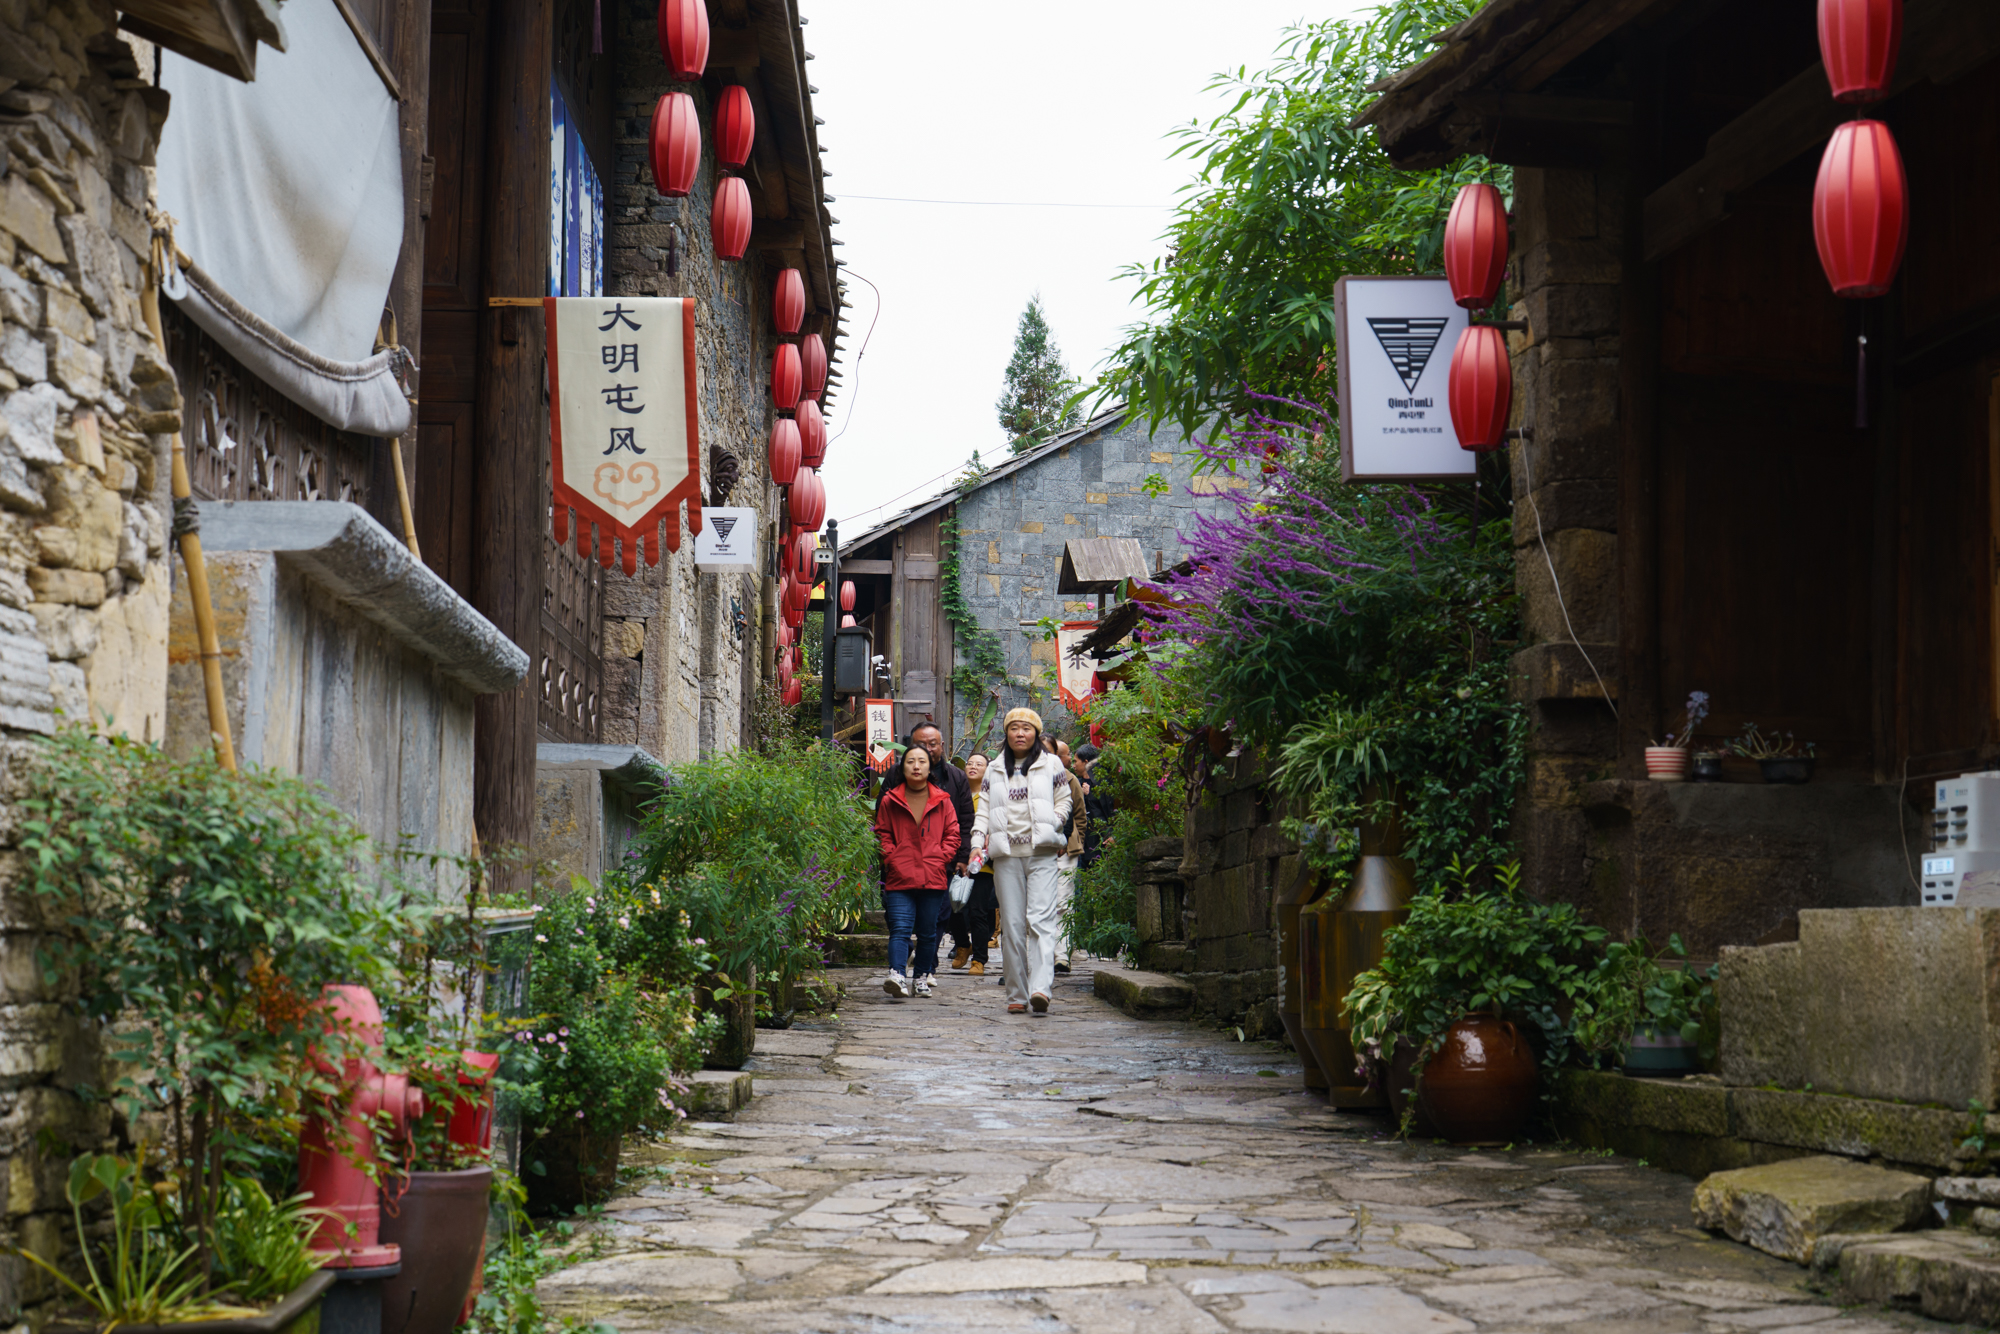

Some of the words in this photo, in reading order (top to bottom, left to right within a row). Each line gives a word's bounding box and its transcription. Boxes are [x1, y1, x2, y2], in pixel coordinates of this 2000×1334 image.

[598, 302, 646, 456] 大明屯风
[1388, 398, 1434, 409] QingTunLi
[871, 709, 888, 741] 钱庄
